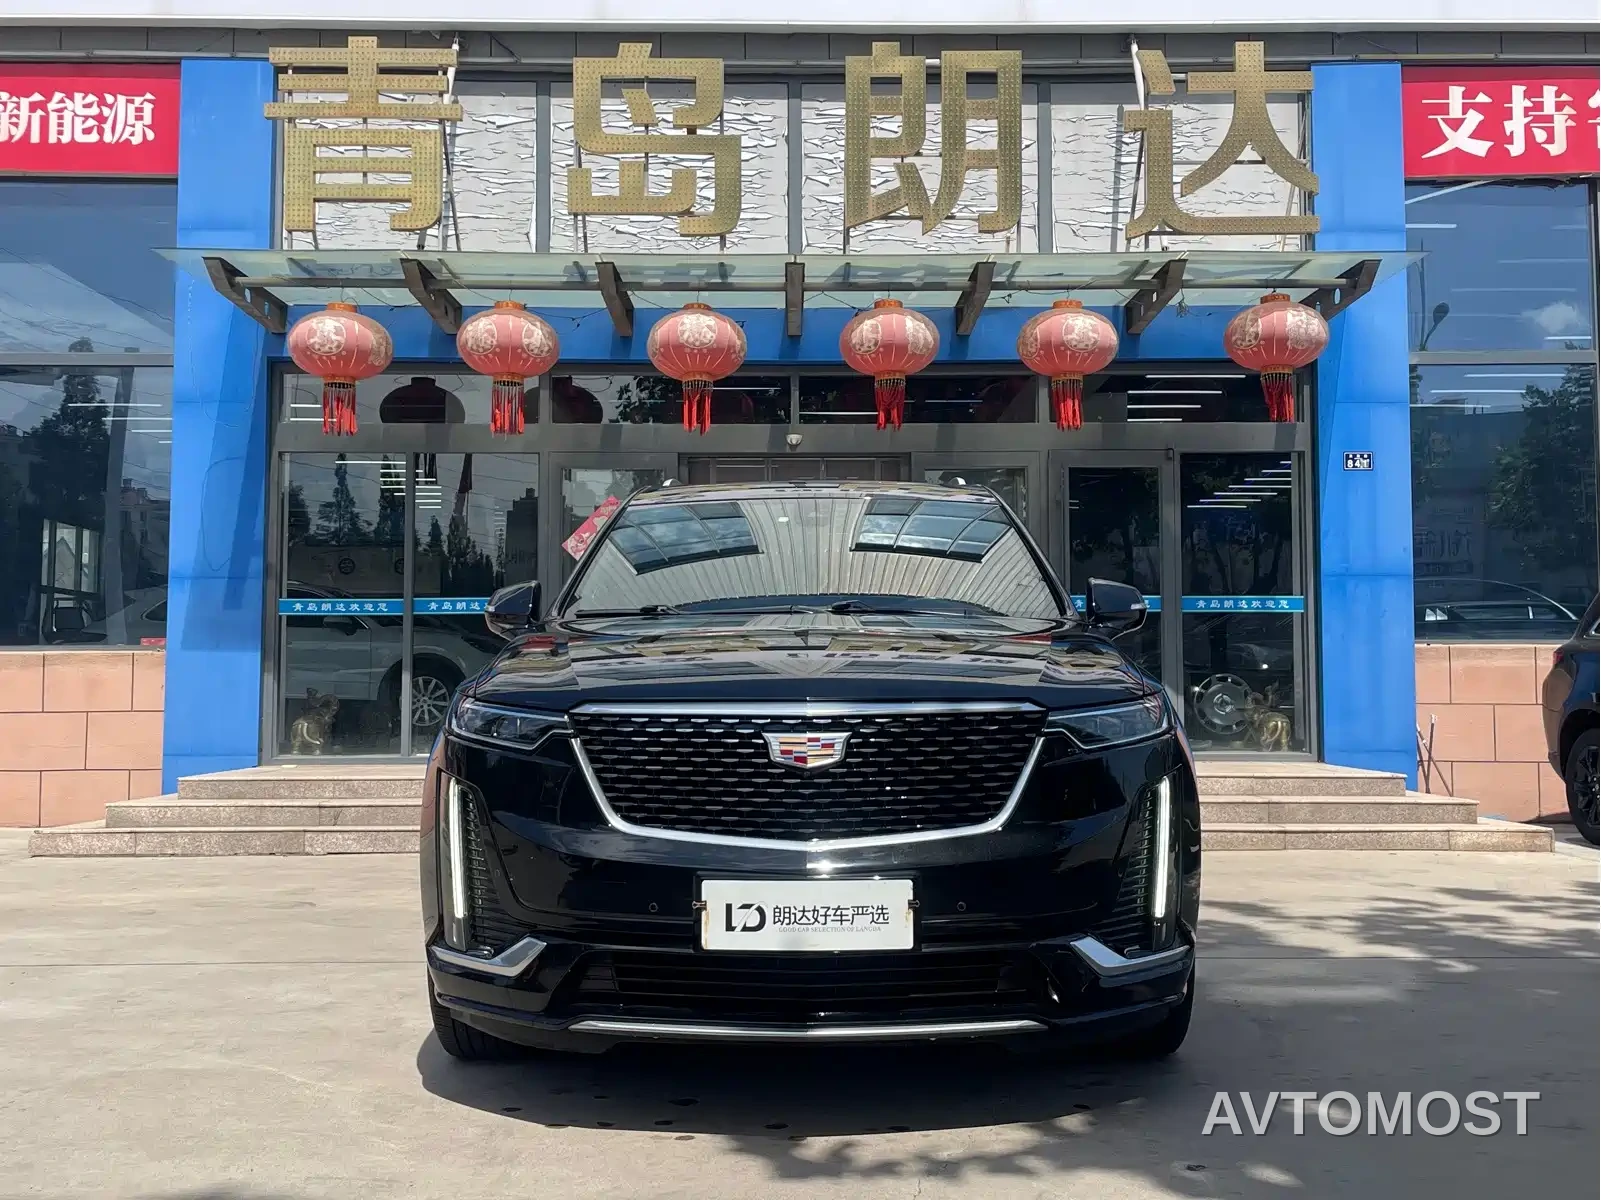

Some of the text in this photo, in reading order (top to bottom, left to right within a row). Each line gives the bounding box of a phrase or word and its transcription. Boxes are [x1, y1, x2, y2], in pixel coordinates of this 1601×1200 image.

[0, 91, 156, 145] 新能源
[264, 36, 1320, 239] 青岛朗达
[292, 602, 388, 612] 青岛朗达欢迎您
[427, 601, 488, 611] 青岛朗达
[1196, 599, 1290, 609] 青岛朗达欢迎您
[772, 904, 889, 925] 朗达好车严选
